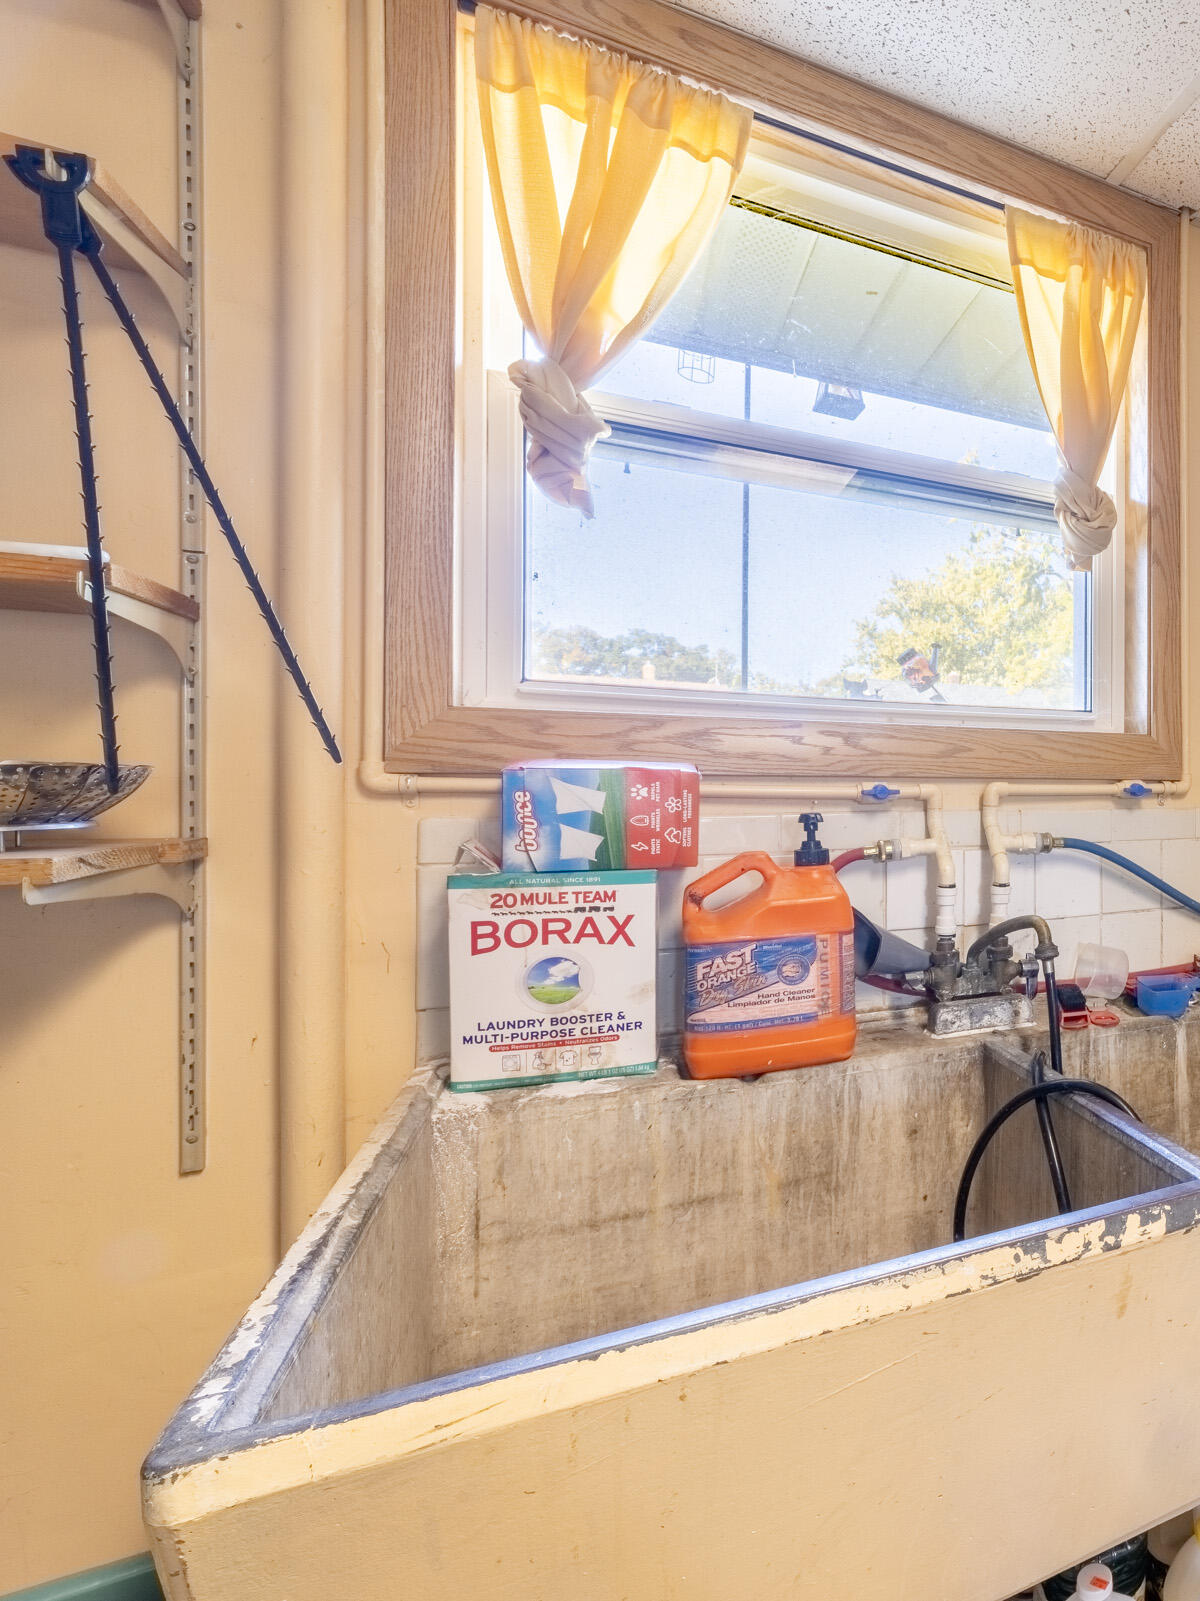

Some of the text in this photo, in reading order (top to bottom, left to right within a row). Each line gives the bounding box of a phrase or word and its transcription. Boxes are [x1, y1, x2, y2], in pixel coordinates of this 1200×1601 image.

[514, 790, 540, 852] bounce
[490, 890, 617, 908] 20 MULE TEAM
[470, 914, 636, 956] BORAX
[696, 944, 758, 980] FAST
[696, 962, 758, 991] ORANGE
[727, 999, 772, 1008] Limpiador
[788, 994, 816, 1002] Manos
[758, 988, 816, 1000] Hand Cleaner
[477, 1011, 626, 1032] LAUNDRY BOOSTER &
[462, 1022, 643, 1044] MULTI-PURPOSE CLEANER
[492, 1044, 510, 1052] Helps
